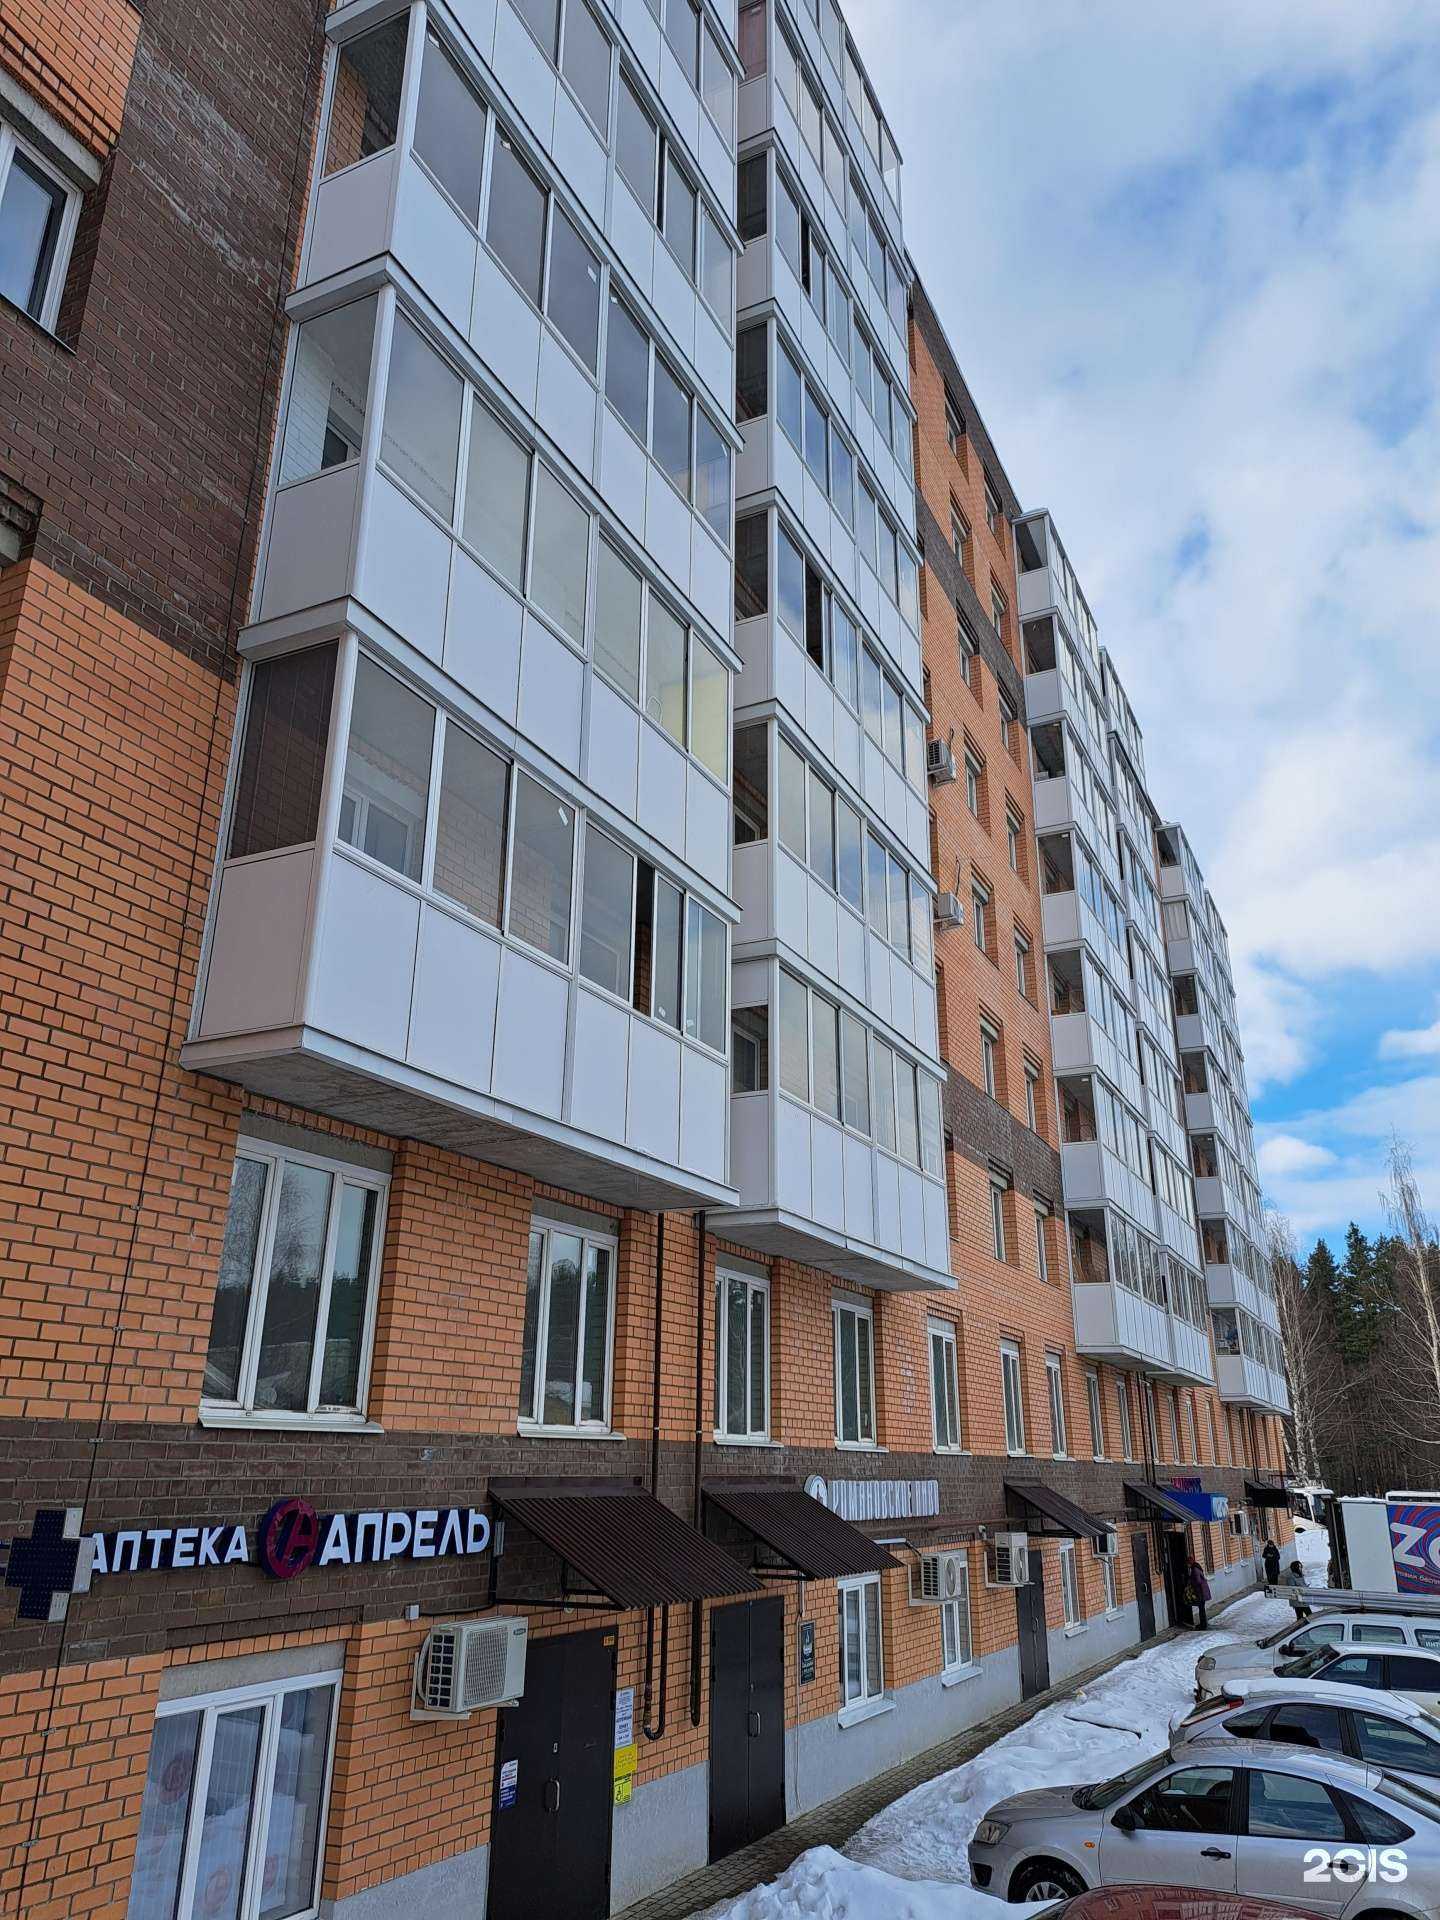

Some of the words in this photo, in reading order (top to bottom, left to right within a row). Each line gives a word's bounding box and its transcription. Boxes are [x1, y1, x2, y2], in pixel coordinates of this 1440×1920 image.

[832, 1479, 913, 1521] РОМАНОВСКОЕ
[915, 1479, 940, 1516] ПИВО
[91, 1525, 250, 1574] АПТЕКА
[319, 1508, 491, 1567] АПРЕЛЬ
